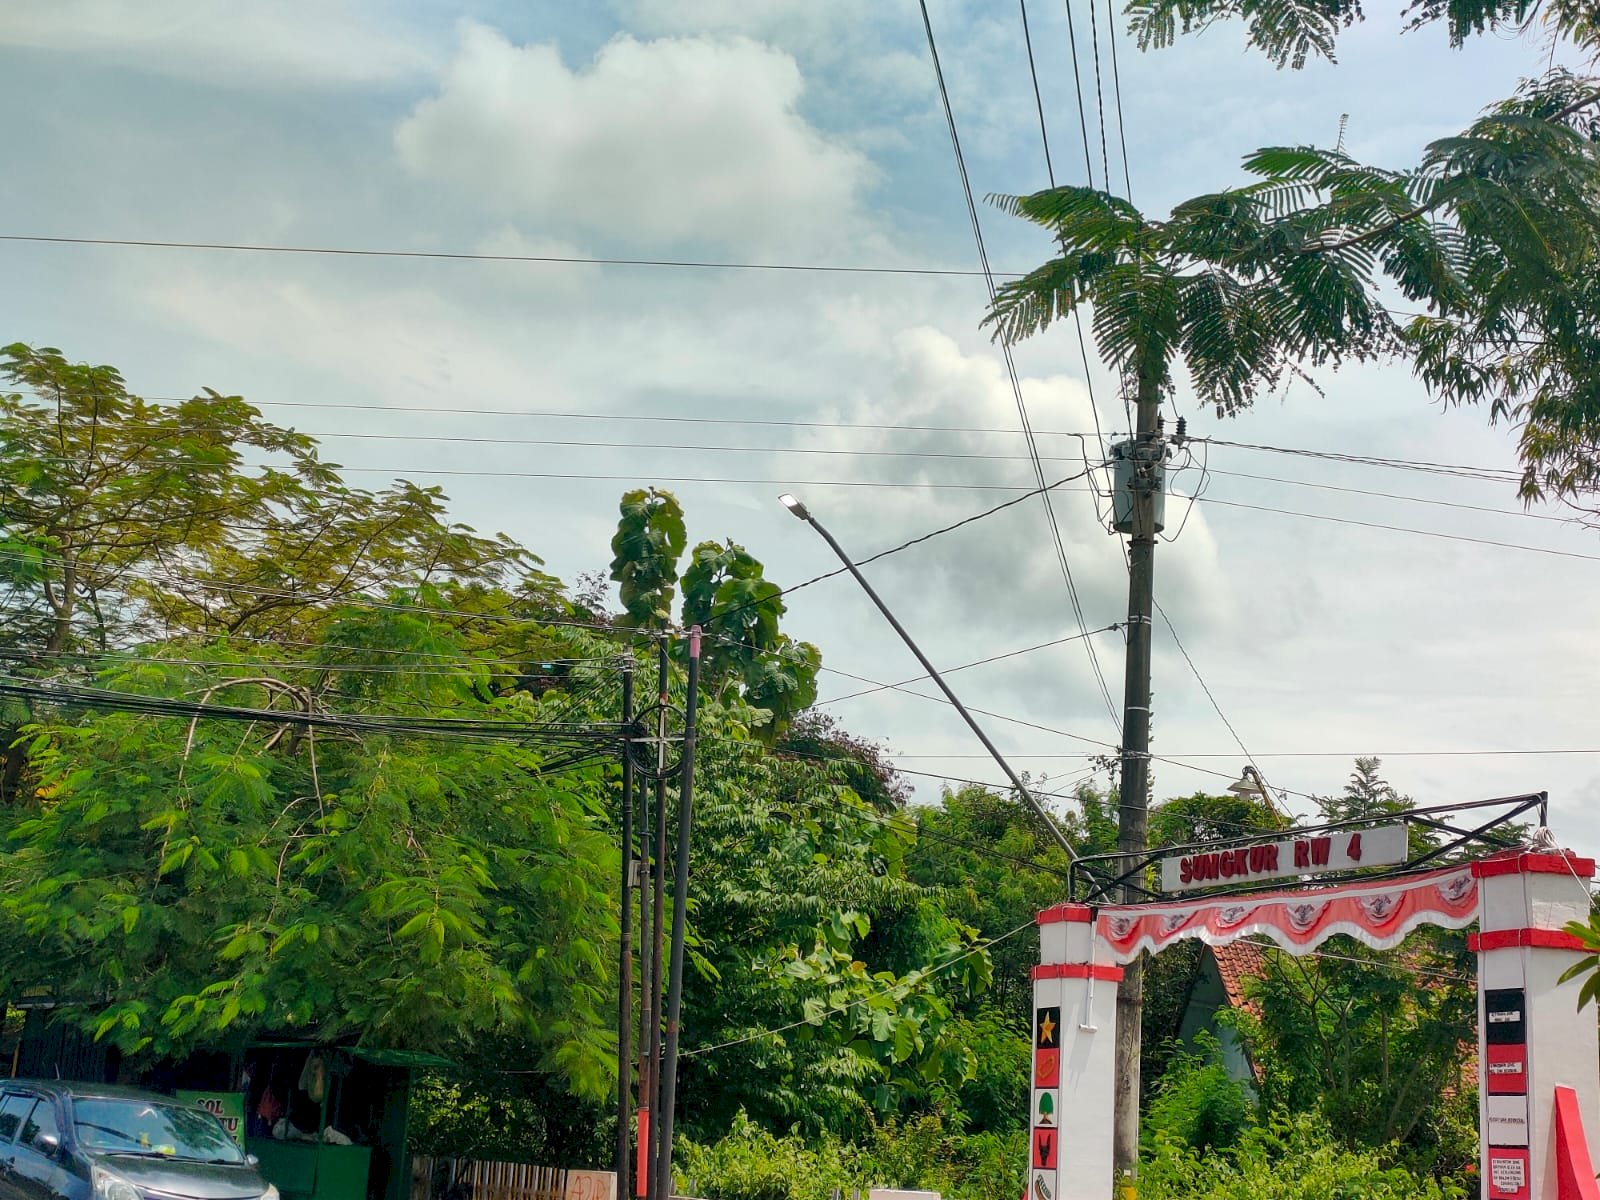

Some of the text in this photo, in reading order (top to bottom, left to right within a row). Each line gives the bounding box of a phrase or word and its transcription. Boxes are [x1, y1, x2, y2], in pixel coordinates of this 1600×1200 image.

[1180, 833, 1361, 883] SUNGKUR RW 4
